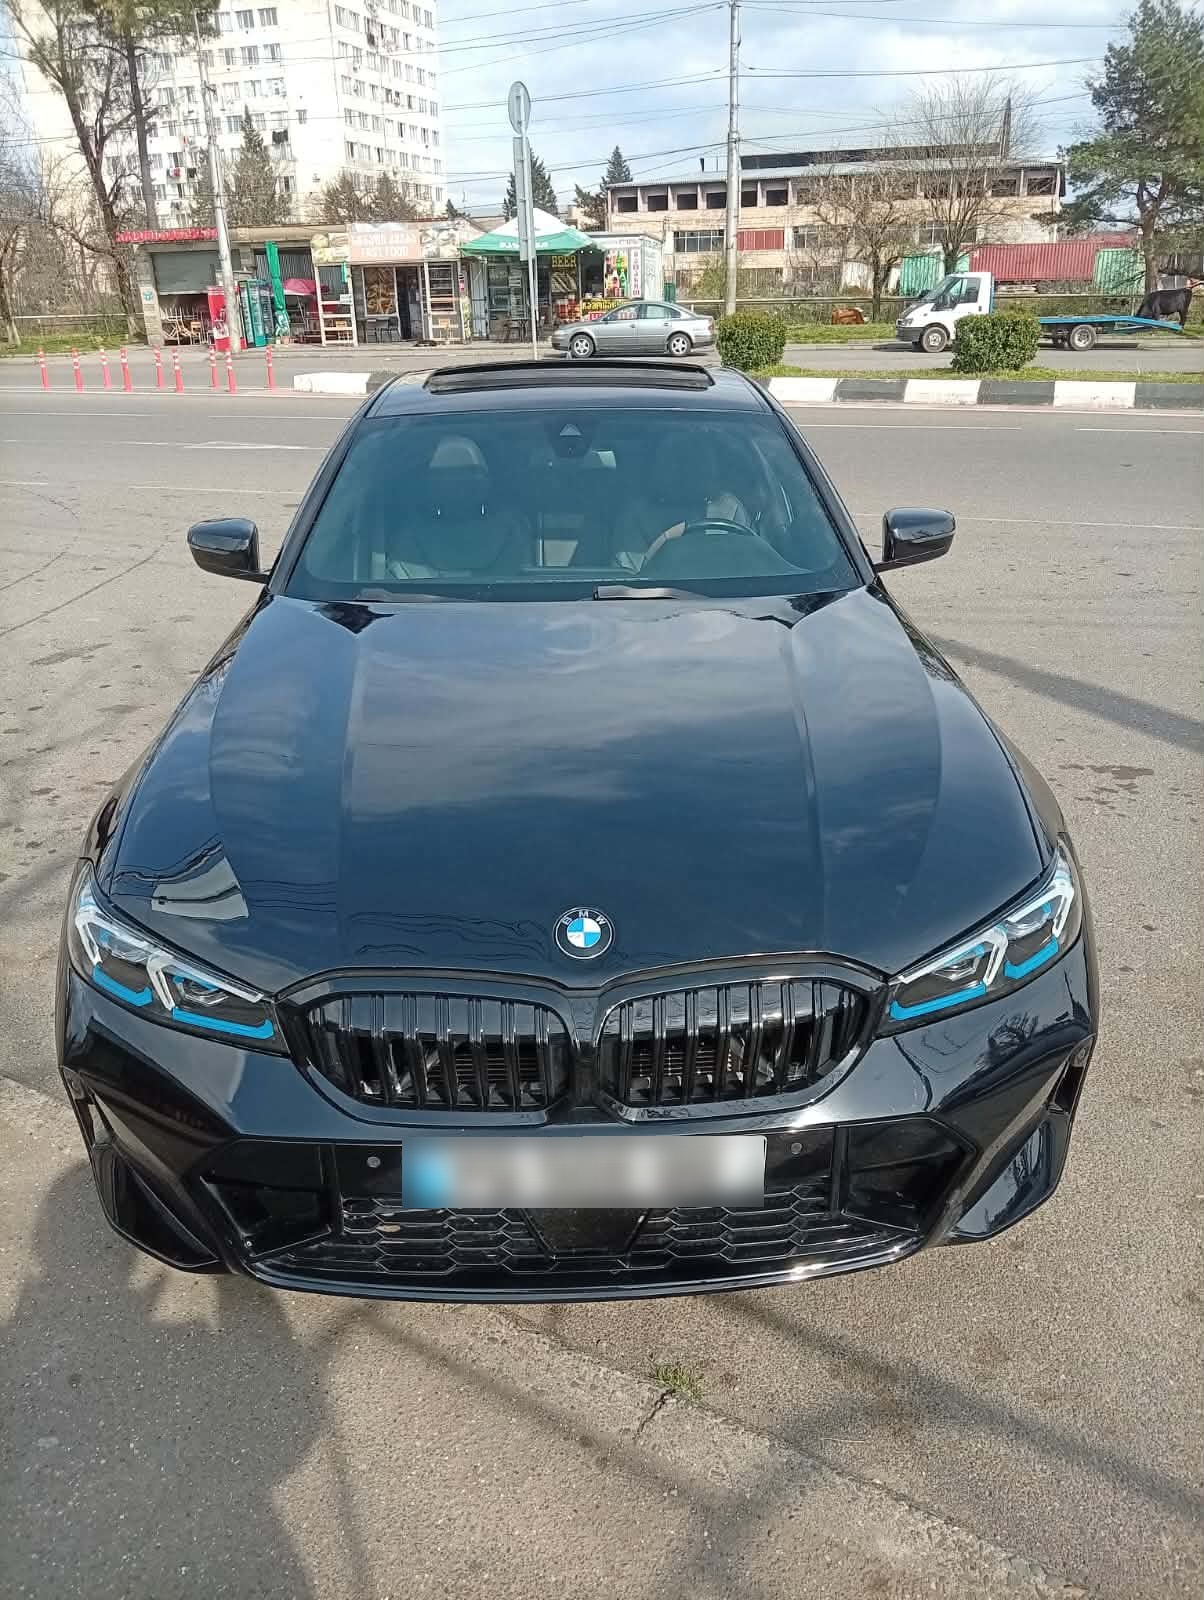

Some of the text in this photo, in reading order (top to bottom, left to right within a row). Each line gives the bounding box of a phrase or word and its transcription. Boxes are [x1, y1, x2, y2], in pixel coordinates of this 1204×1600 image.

[384, 247, 409, 257] FOOD
[551, 255, 577, 266] BEER
[562, 910, 607, 925] BMW
